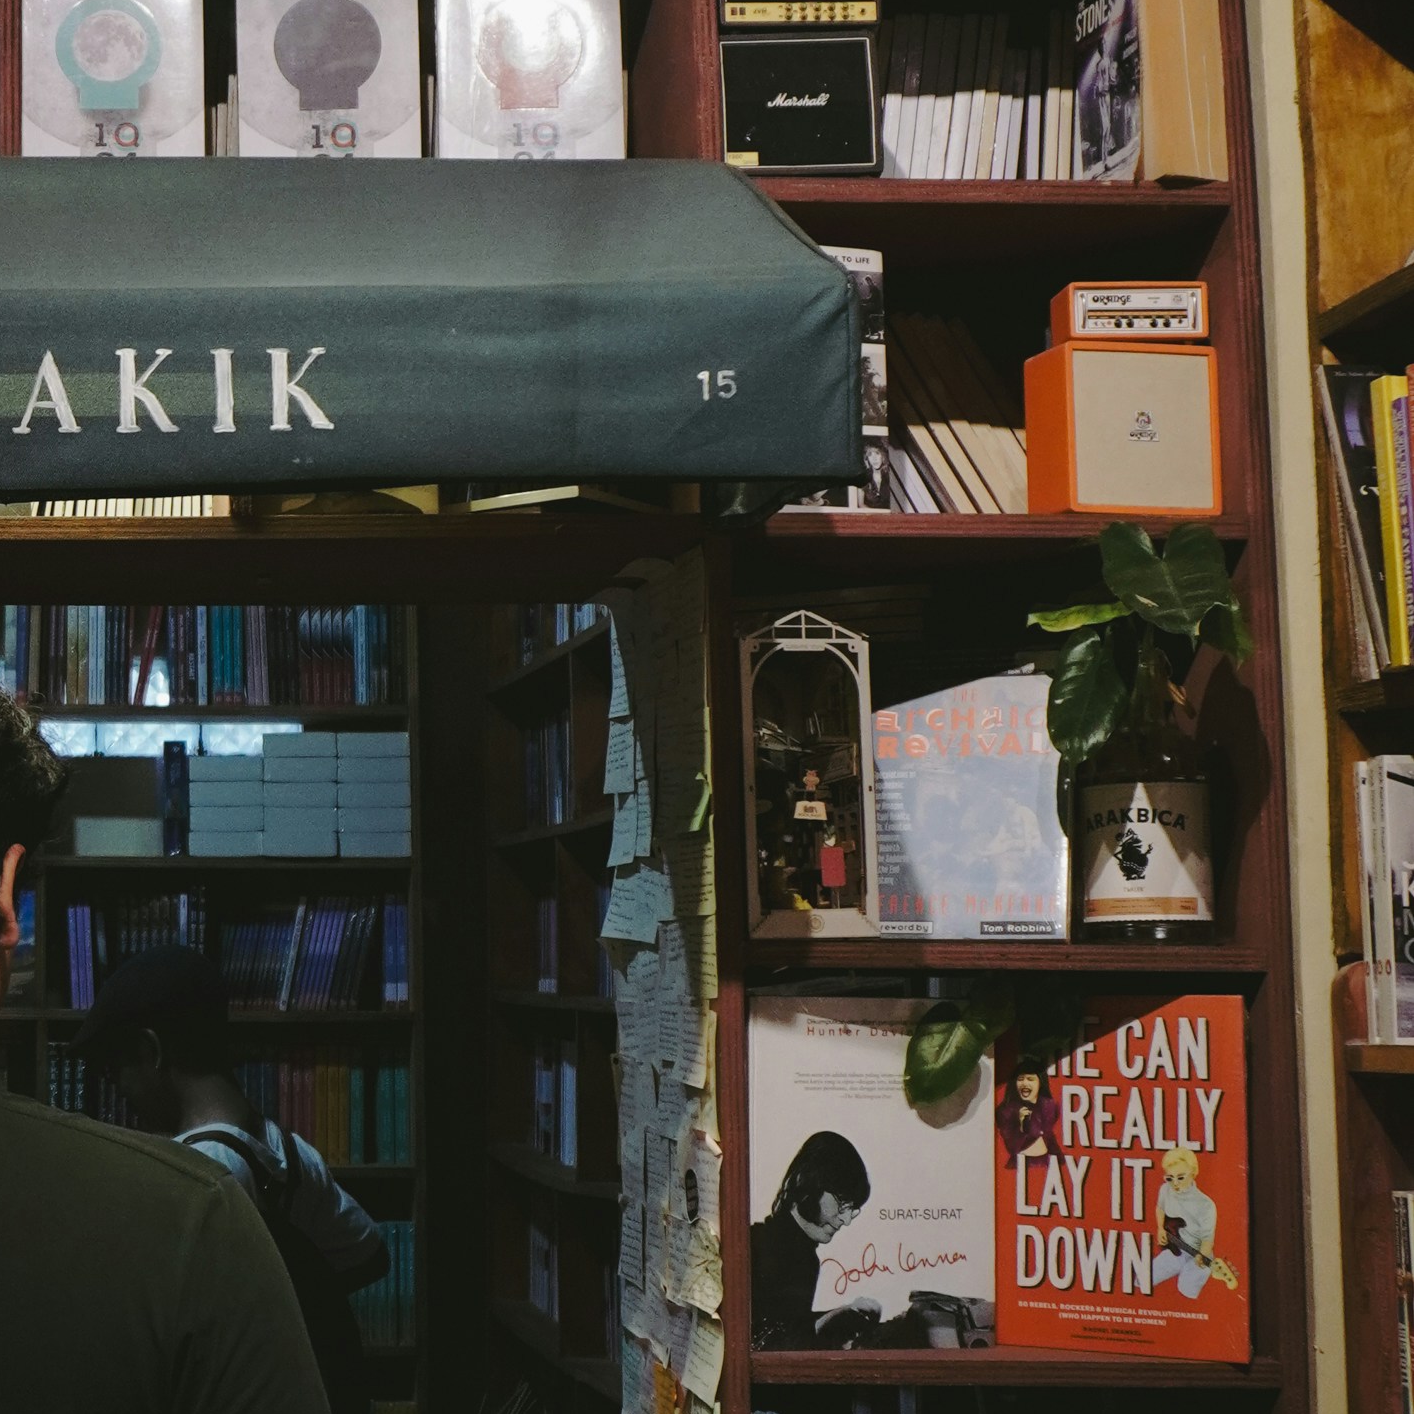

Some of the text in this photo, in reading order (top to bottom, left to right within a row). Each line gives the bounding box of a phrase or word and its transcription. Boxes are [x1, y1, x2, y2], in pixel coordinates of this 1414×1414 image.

[766, 91, 832, 110] Marshall
[855, 255, 871, 265] LIFE
[694, 366, 738, 405] 15
[983, 923, 1053, 933] Tom Robbins
[806, 1026, 861, 1037] Hunter
[1114, 1016, 1209, 1083] CAN
[1061, 1084, 1224, 1154] REALLY
[1014, 1153, 1154, 1224] LAY IT
[878, 1207, 963, 1221] SURAT-SURAT
[820, 1242, 894, 1297] John
[1014, 1224, 1153, 1297] DOWN
